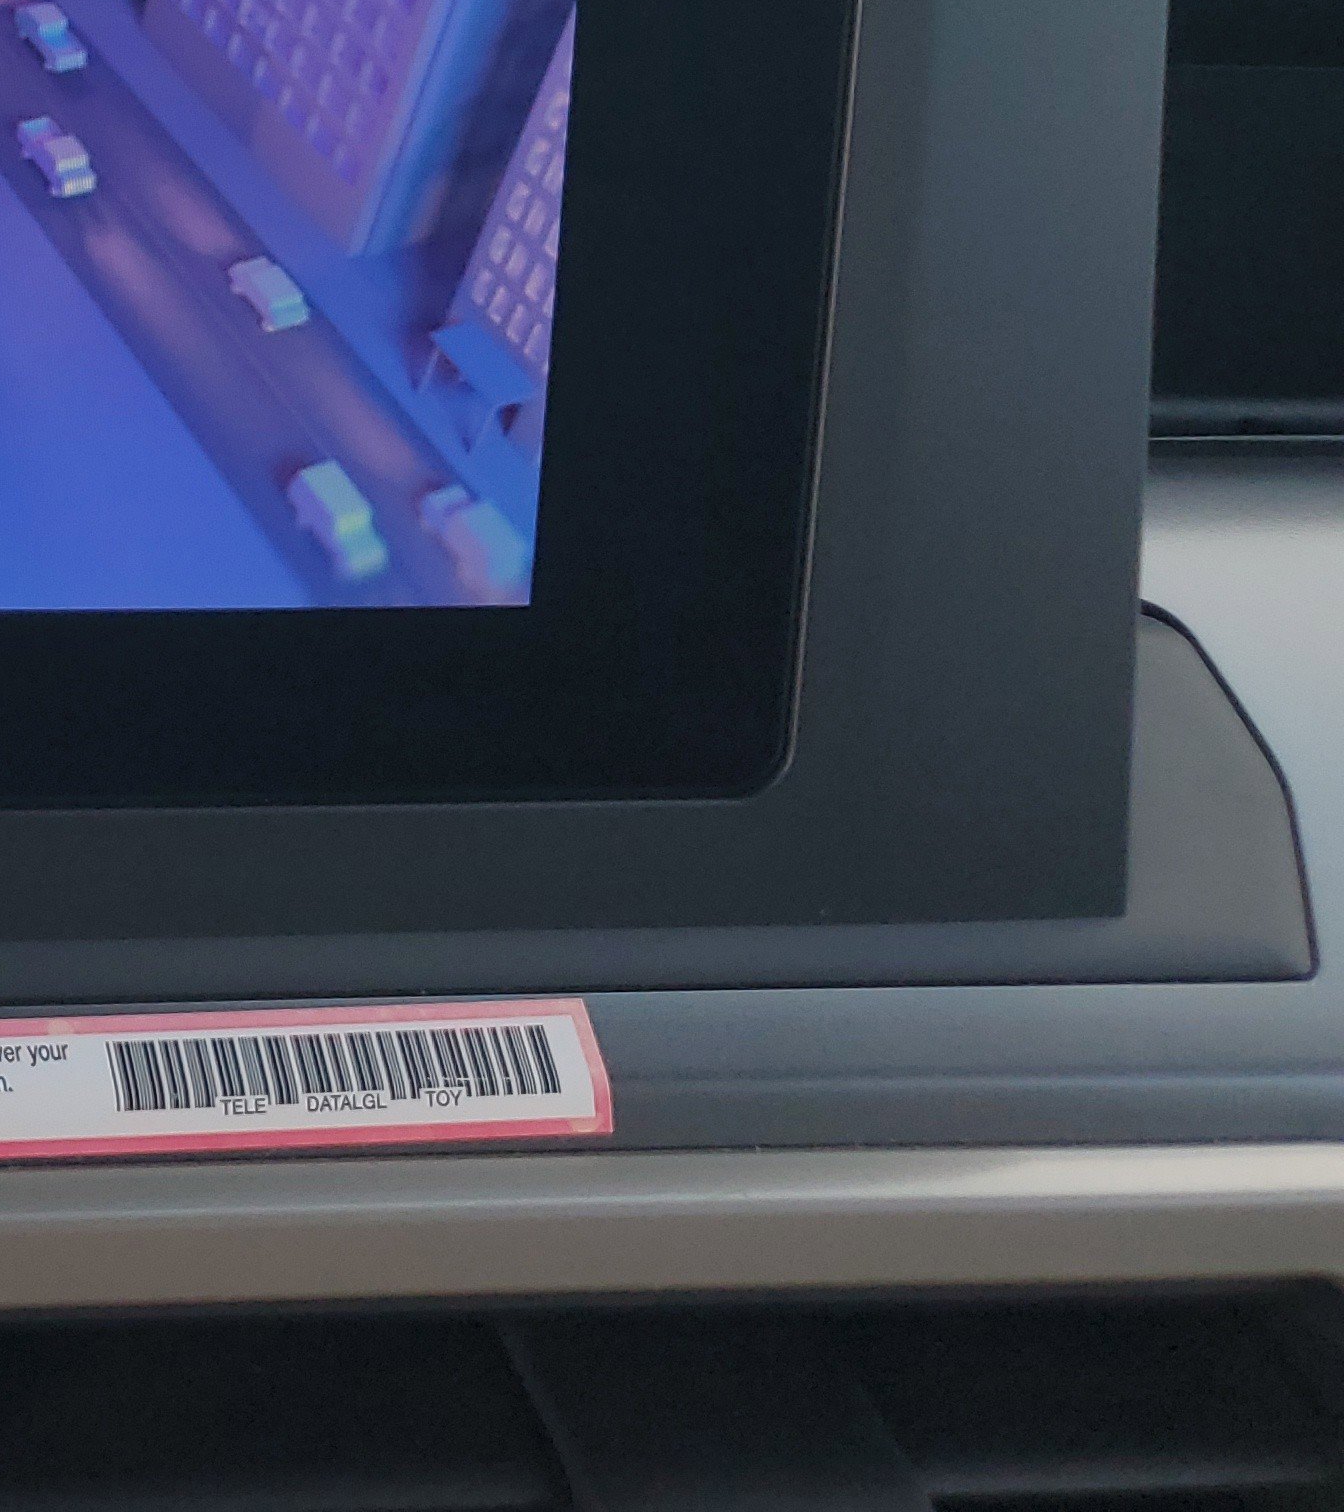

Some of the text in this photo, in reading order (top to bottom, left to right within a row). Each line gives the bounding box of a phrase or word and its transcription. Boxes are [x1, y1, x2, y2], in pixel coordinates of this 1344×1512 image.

[27, 1041, 68, 1067] your
[220, 1089, 462, 1116] TELE DATALGL TOY
